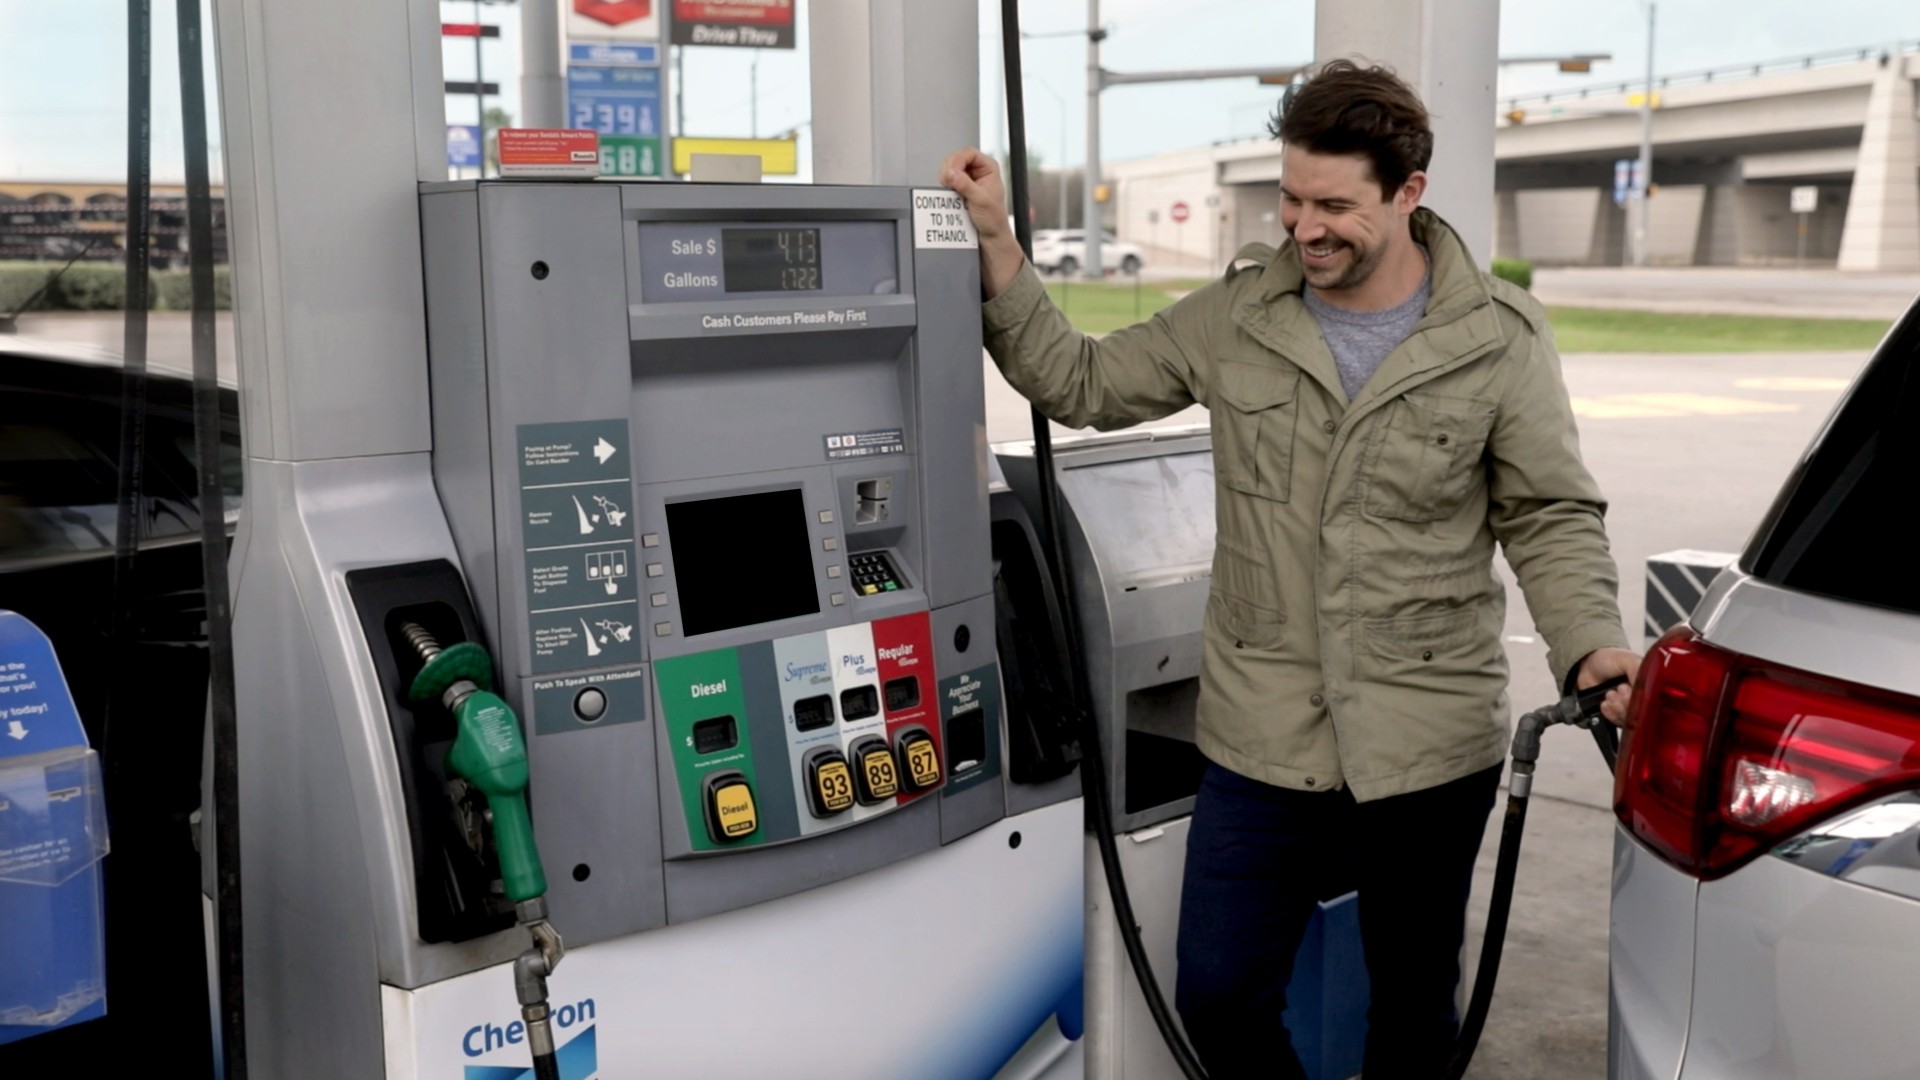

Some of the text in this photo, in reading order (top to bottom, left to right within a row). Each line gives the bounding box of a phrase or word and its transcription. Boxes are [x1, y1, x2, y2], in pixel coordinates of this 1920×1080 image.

[692, 24, 778, 45] Drive Thru
[915, 196, 961, 210] CONTAINS
[930, 213, 963, 226] TO 10%
[926, 229, 968, 242] ETHANOL
[671, 238, 716, 256] Sale $
[663, 271, 718, 288] Gallons
[702, 309, 867, 328] Cash Customers Please Pay First
[843, 655, 865, 667] Plus
[878, 644, 914, 661] Regular
[534, 682, 553, 690] Push
[565, 678, 587, 687] Speak
[588, 675, 605, 683] With
[606, 670, 641, 681] Attendant
[784, 662, 827, 682] Supreme
[13, 681, 37, 693] you!
[691, 679, 727, 698] Diesel
[949, 681, 981, 698] Appreciate
[11, 703, 48, 716] today!
[952, 700, 979, 715] Business
[685, 736, 693, 747] $
[912, 751, 932, 775] 87
[869, 762, 893, 786] 89
[823, 774, 848, 798] 93
[722, 802, 749, 816] Diesel
[462, 998, 595, 1057] Cheron
